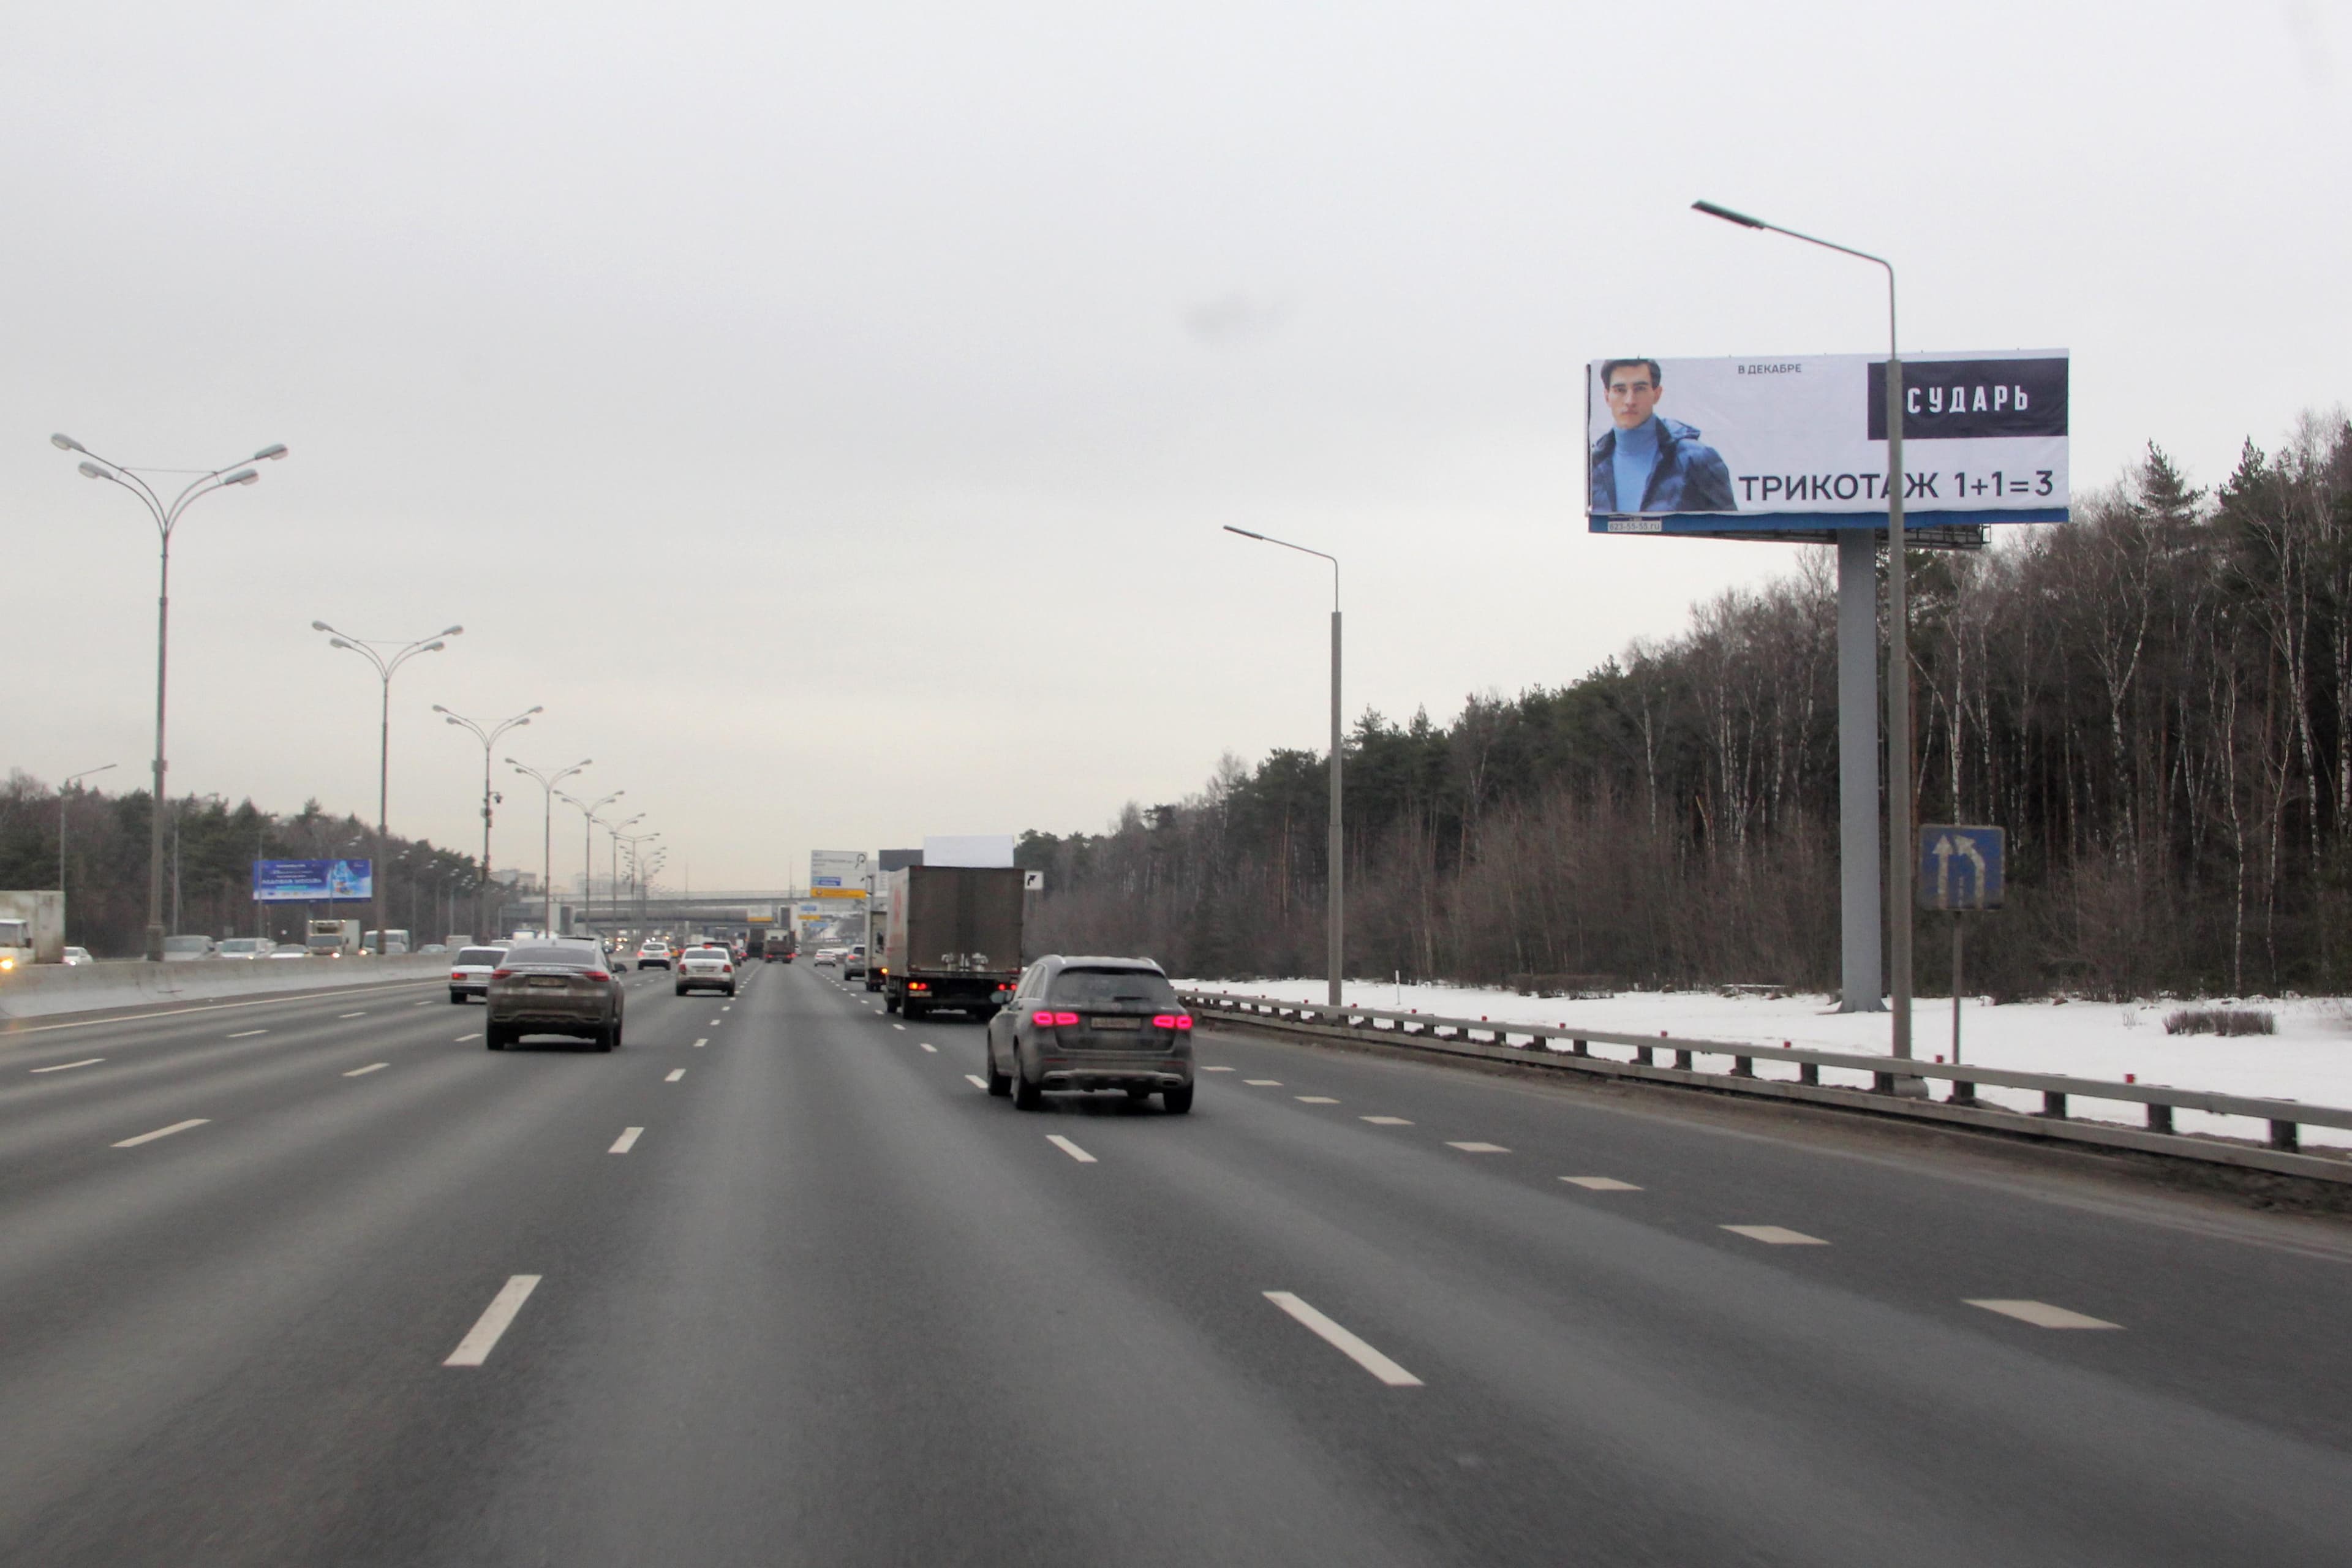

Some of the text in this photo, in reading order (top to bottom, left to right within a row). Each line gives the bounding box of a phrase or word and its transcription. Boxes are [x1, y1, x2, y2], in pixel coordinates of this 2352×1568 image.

[1738, 363, 1802, 375] В ДЕКАБРЕ
[1907, 385, 2028, 414] СУДАРЬ
[1954, 470, 2053, 497] 1+1=3
